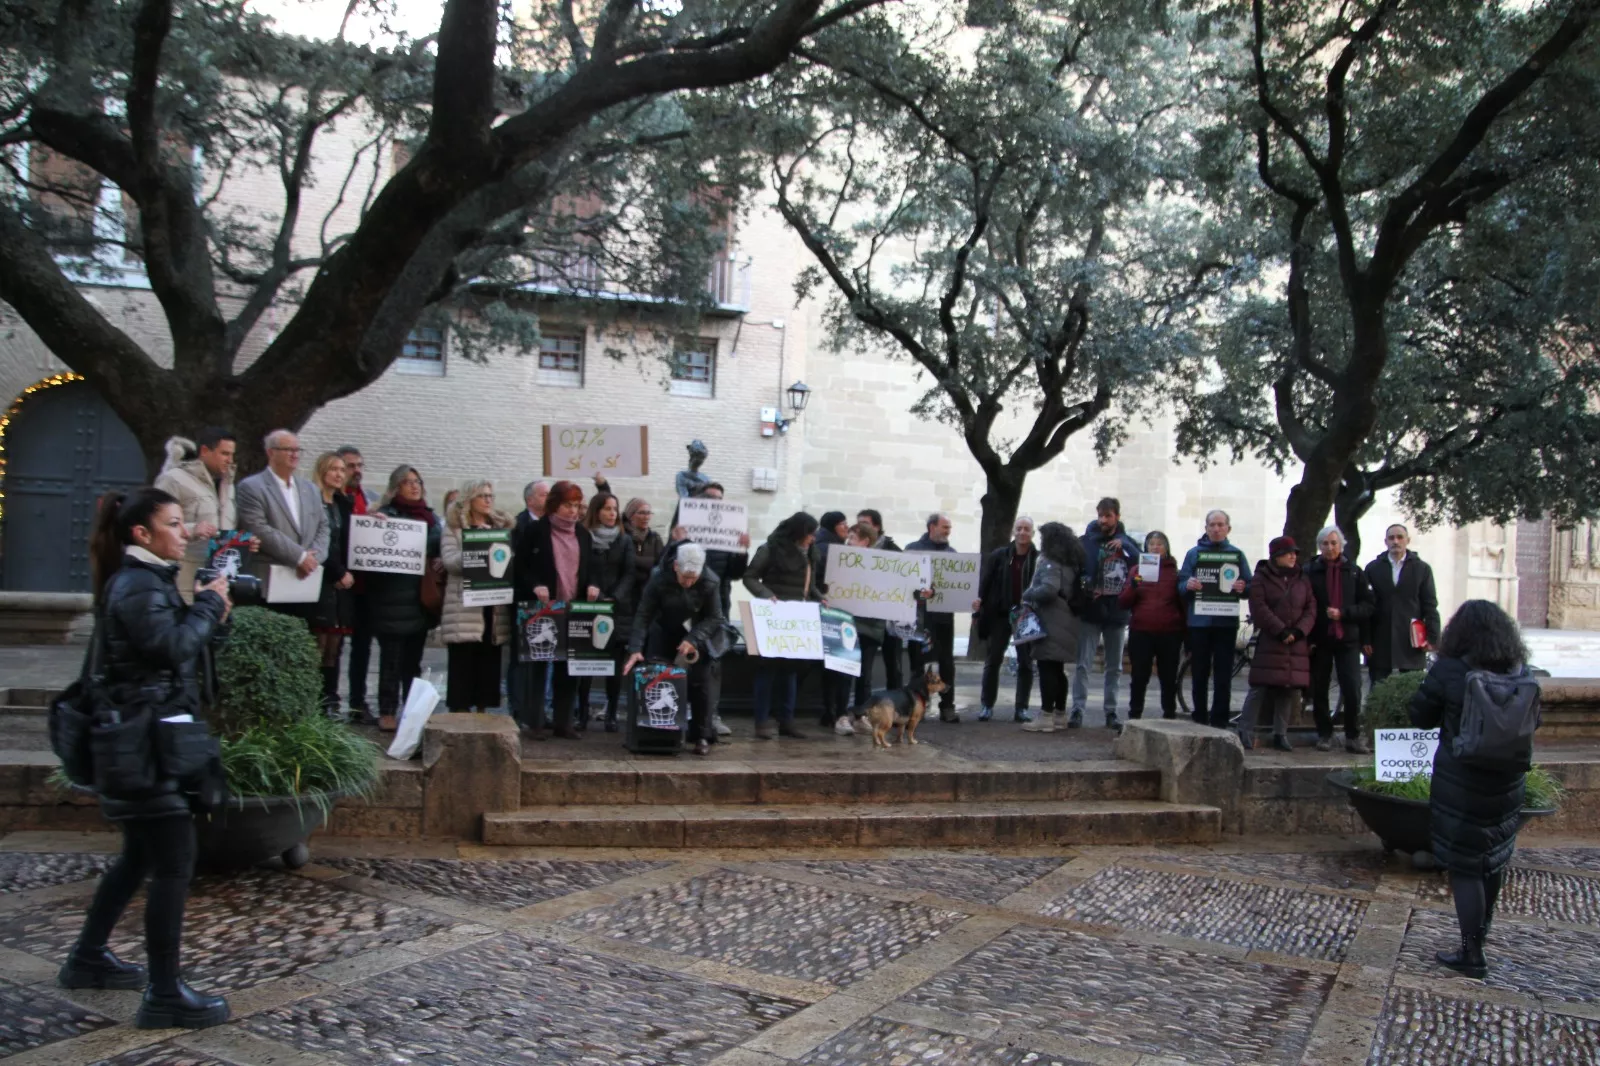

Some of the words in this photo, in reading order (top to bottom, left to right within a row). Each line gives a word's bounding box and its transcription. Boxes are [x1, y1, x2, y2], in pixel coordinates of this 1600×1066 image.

[355, 519, 371, 528] NO
[372, 521, 384, 529] AL
[353, 546, 422, 558] COOPERACIÓN
[354, 559, 364, 567] AL
[366, 559, 421, 571] DESARROLLO
[839, 552, 866, 570] POR
[870, 555, 921, 577] JUSTICIA
[755, 605, 773, 617] LOS
[766, 619, 820, 632] RECORTES
[766, 635, 820, 653] MATAN
[1380, 732, 1396, 741] NO
[1398, 732, 1410, 741] AL
